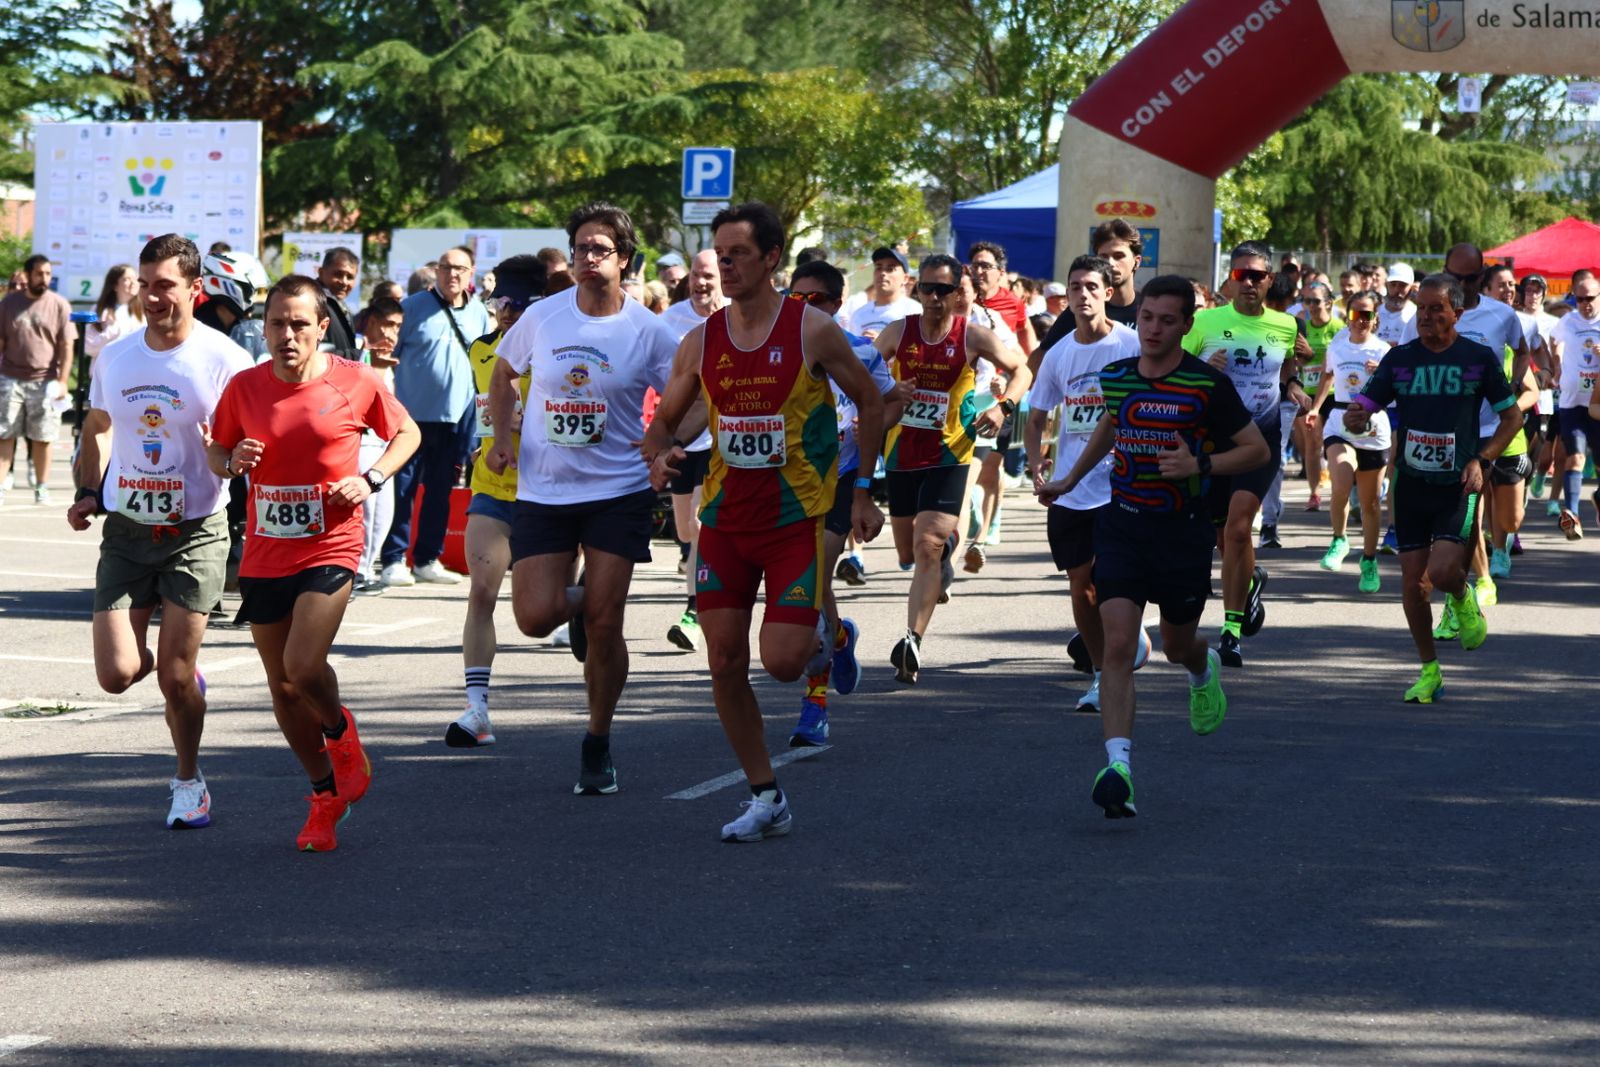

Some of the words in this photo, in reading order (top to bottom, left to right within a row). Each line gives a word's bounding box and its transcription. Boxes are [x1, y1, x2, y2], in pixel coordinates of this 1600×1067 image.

[1477, 9, 1500, 28] de
[1121, 91, 1172, 138] CON
[1170, 68, 1205, 96] EL
[692, 154, 723, 196] P
[80, 280, 92, 296] 2
[1409, 365, 1462, 395] AVS
[545, 400, 606, 414] bedunia
[738, 400, 772, 412] TORO
[904, 400, 940, 421] 422
[1139, 402, 1179, 415] XXXVIII
[553, 414, 595, 435] 395
[719, 418, 783, 433] bedunia
[728, 433, 773, 456] 480
[1408, 432, 1454, 446] bedunia
[1412, 444, 1447, 462] 425
[118, 475, 183, 491] bedunia
[126, 491, 172, 513] 413
[256, 487, 320, 502] bedunia
[265, 503, 311, 526] 488
